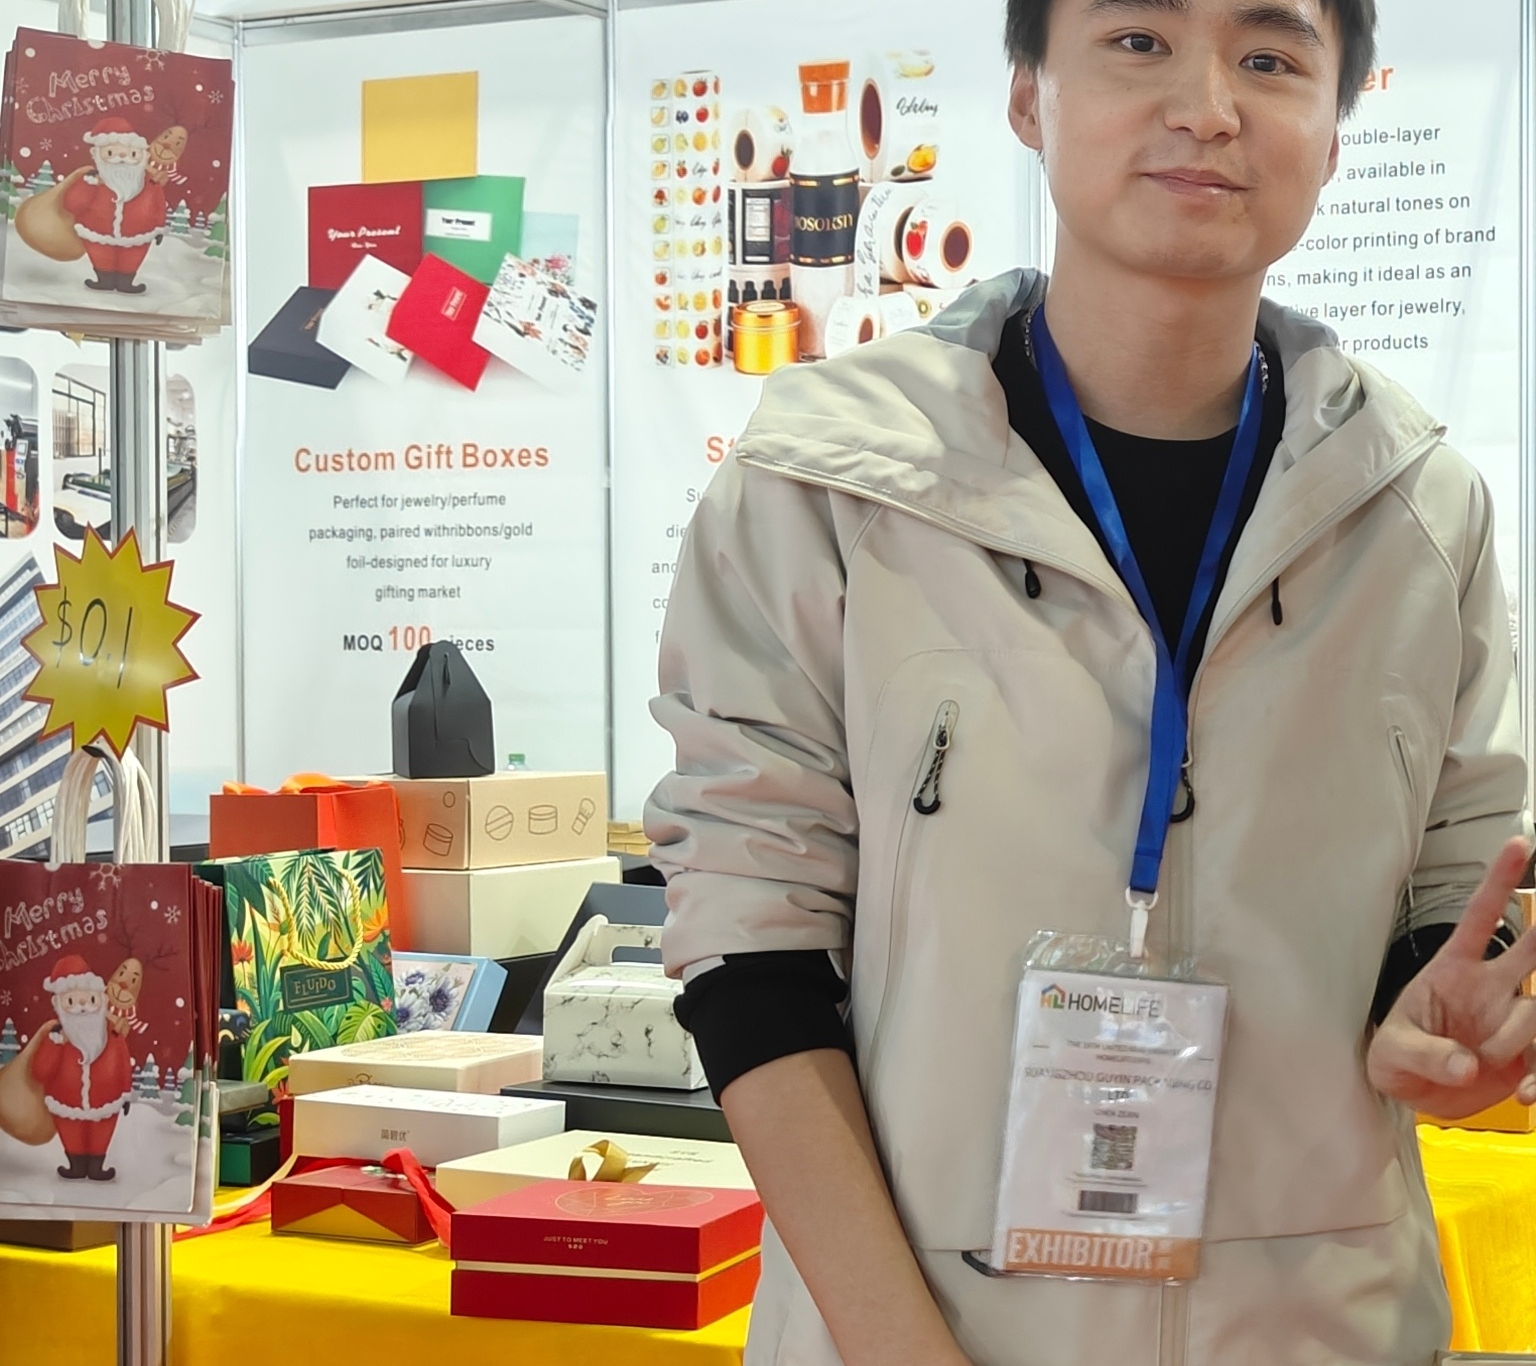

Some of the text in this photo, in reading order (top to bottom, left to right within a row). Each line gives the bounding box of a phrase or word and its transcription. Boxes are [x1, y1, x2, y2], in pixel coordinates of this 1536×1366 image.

[48, 66, 131, 98] Merry
[26, 86, 155, 123] Christmas
[1341, 126, 1441, 146] ouble-layer
[1346, 159, 1446, 180] available in
[1330, 197, 1390, 215] natural
[1395, 196, 1444, 212] tones
[1449, 195, 1470, 209] on
[1292, 226, 1496, 252] -color printing of brand
[1266, 265, 1472, 287] ns, making it ideal as an
[1324, 298, 1465, 322] layer for jewelry,
[1352, 334, 1429, 354] products
[295, 443, 549, 472] Custom Gift Boxes
[333, 492, 506, 510] Perfect for jewelry/perfume
[309, 523, 533, 542] packaging, paired withribbons/gold
[346, 554, 492, 571] foil-designed for luxury
[375, 586, 461, 602] gifting market
[52, 586, 133, 689] $0.1
[343, 625, 431, 651] MOQ 100
[4, 887, 84, 939] Merry
[294, 977, 336, 995] FLUIDO
[1009, 1232, 1152, 1269] EXHIBITOR
